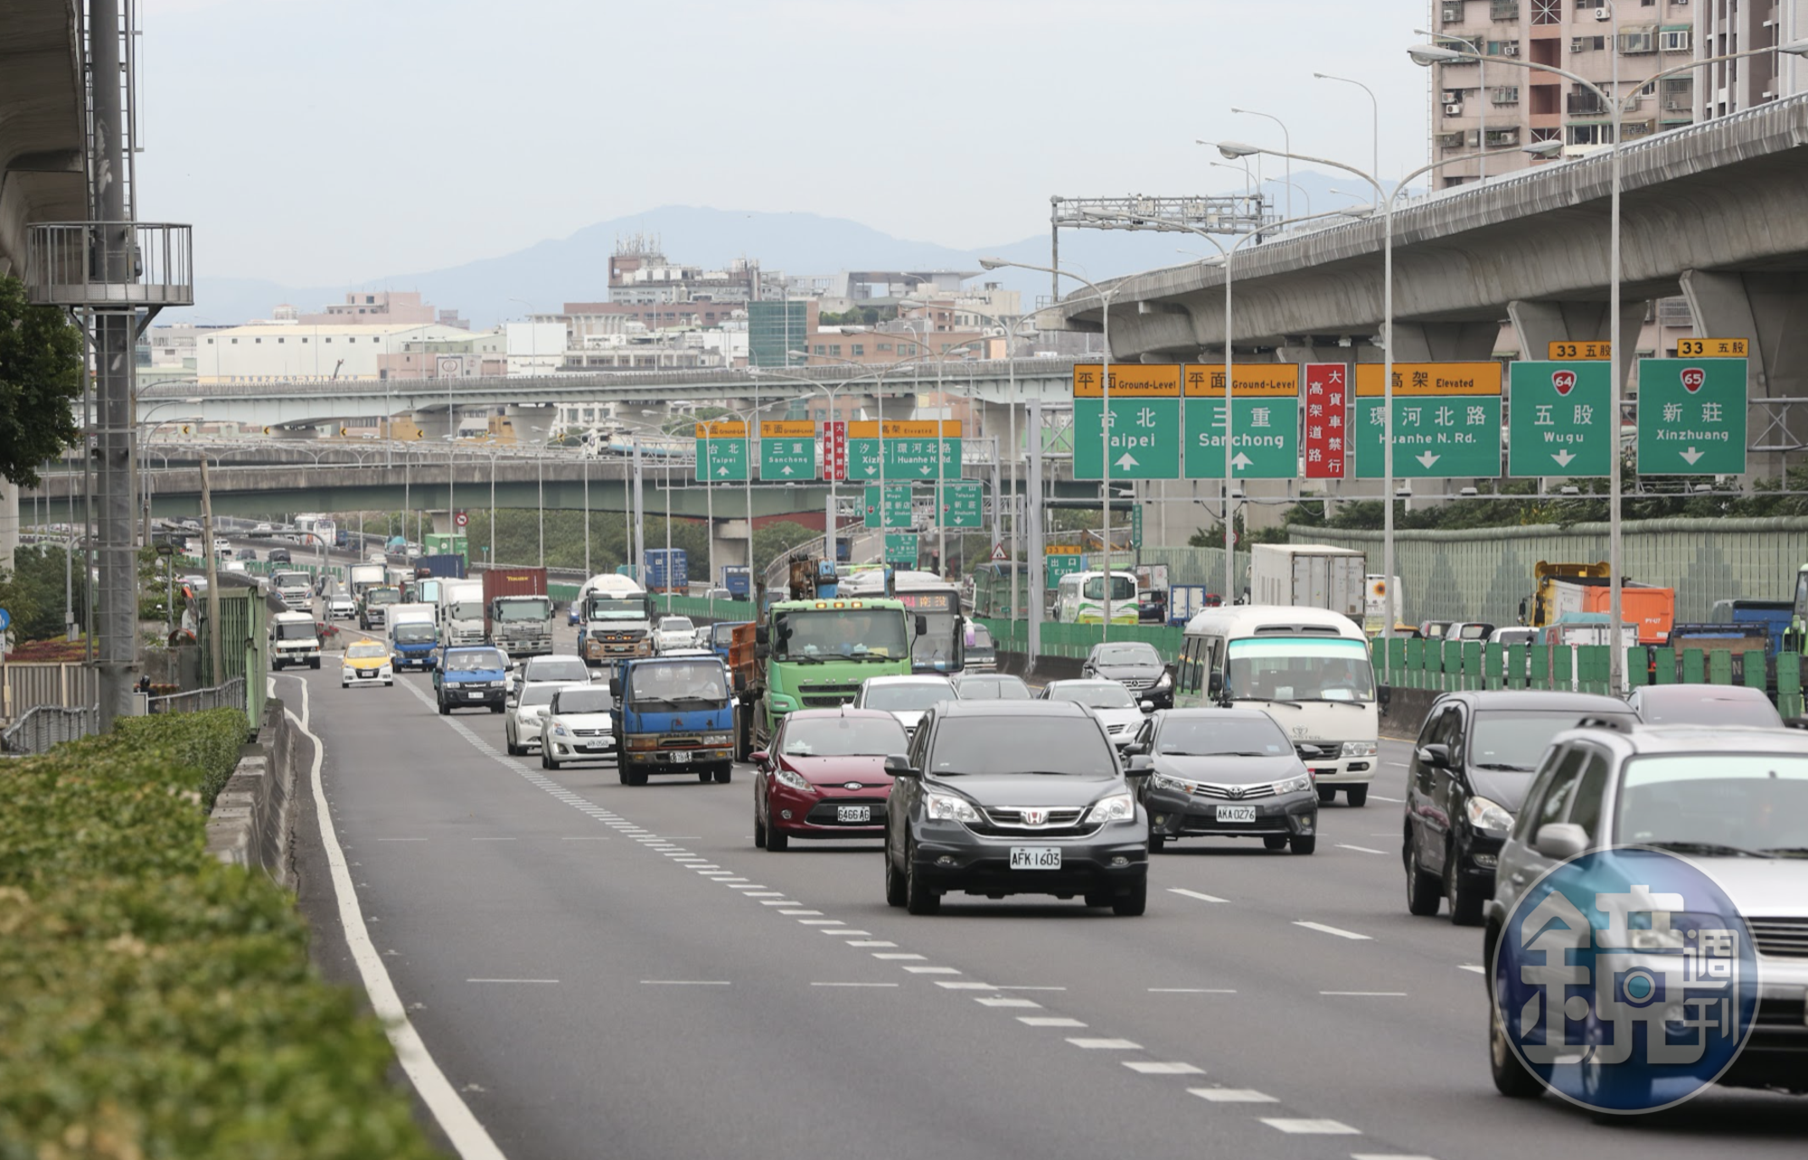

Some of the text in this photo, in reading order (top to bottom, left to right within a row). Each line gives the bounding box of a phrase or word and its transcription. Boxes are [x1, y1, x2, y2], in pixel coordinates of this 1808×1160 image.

[1557, 345, 1576, 357] 33
[1682, 342, 1744, 354] 33 五股
[1078, 372, 1176, 389] 平面 Ground-Level
[1189, 372, 1295, 389] 平面 Ground-Level
[1392, 371, 1474, 388] 高架 Elevated
[1555, 376, 1572, 387] 64
[1684, 374, 1702, 384] 65
[1098, 407, 1156, 428] 台北
[1212, 407, 1271, 427] 三重
[1370, 406, 1486, 426] 環河北路
[1534, 405, 1593, 425] 五股
[1663, 402, 1722, 422] 新莊
[1309, 382, 1323, 462] 高架道路
[1328, 370, 1342, 473] 大貨車禁行
[1437, 433, 1450, 444] N.
[1455, 433, 1476, 443] Rd.
[1544, 432, 1584, 444] Wugu
[1656, 430, 1728, 442] Xinzhuang
[708, 444, 738, 454] 台北
[772, 443, 803, 454] 三重
[712, 456, 736, 464] Taipei
[1051, 558, 1076, 567] 出口
